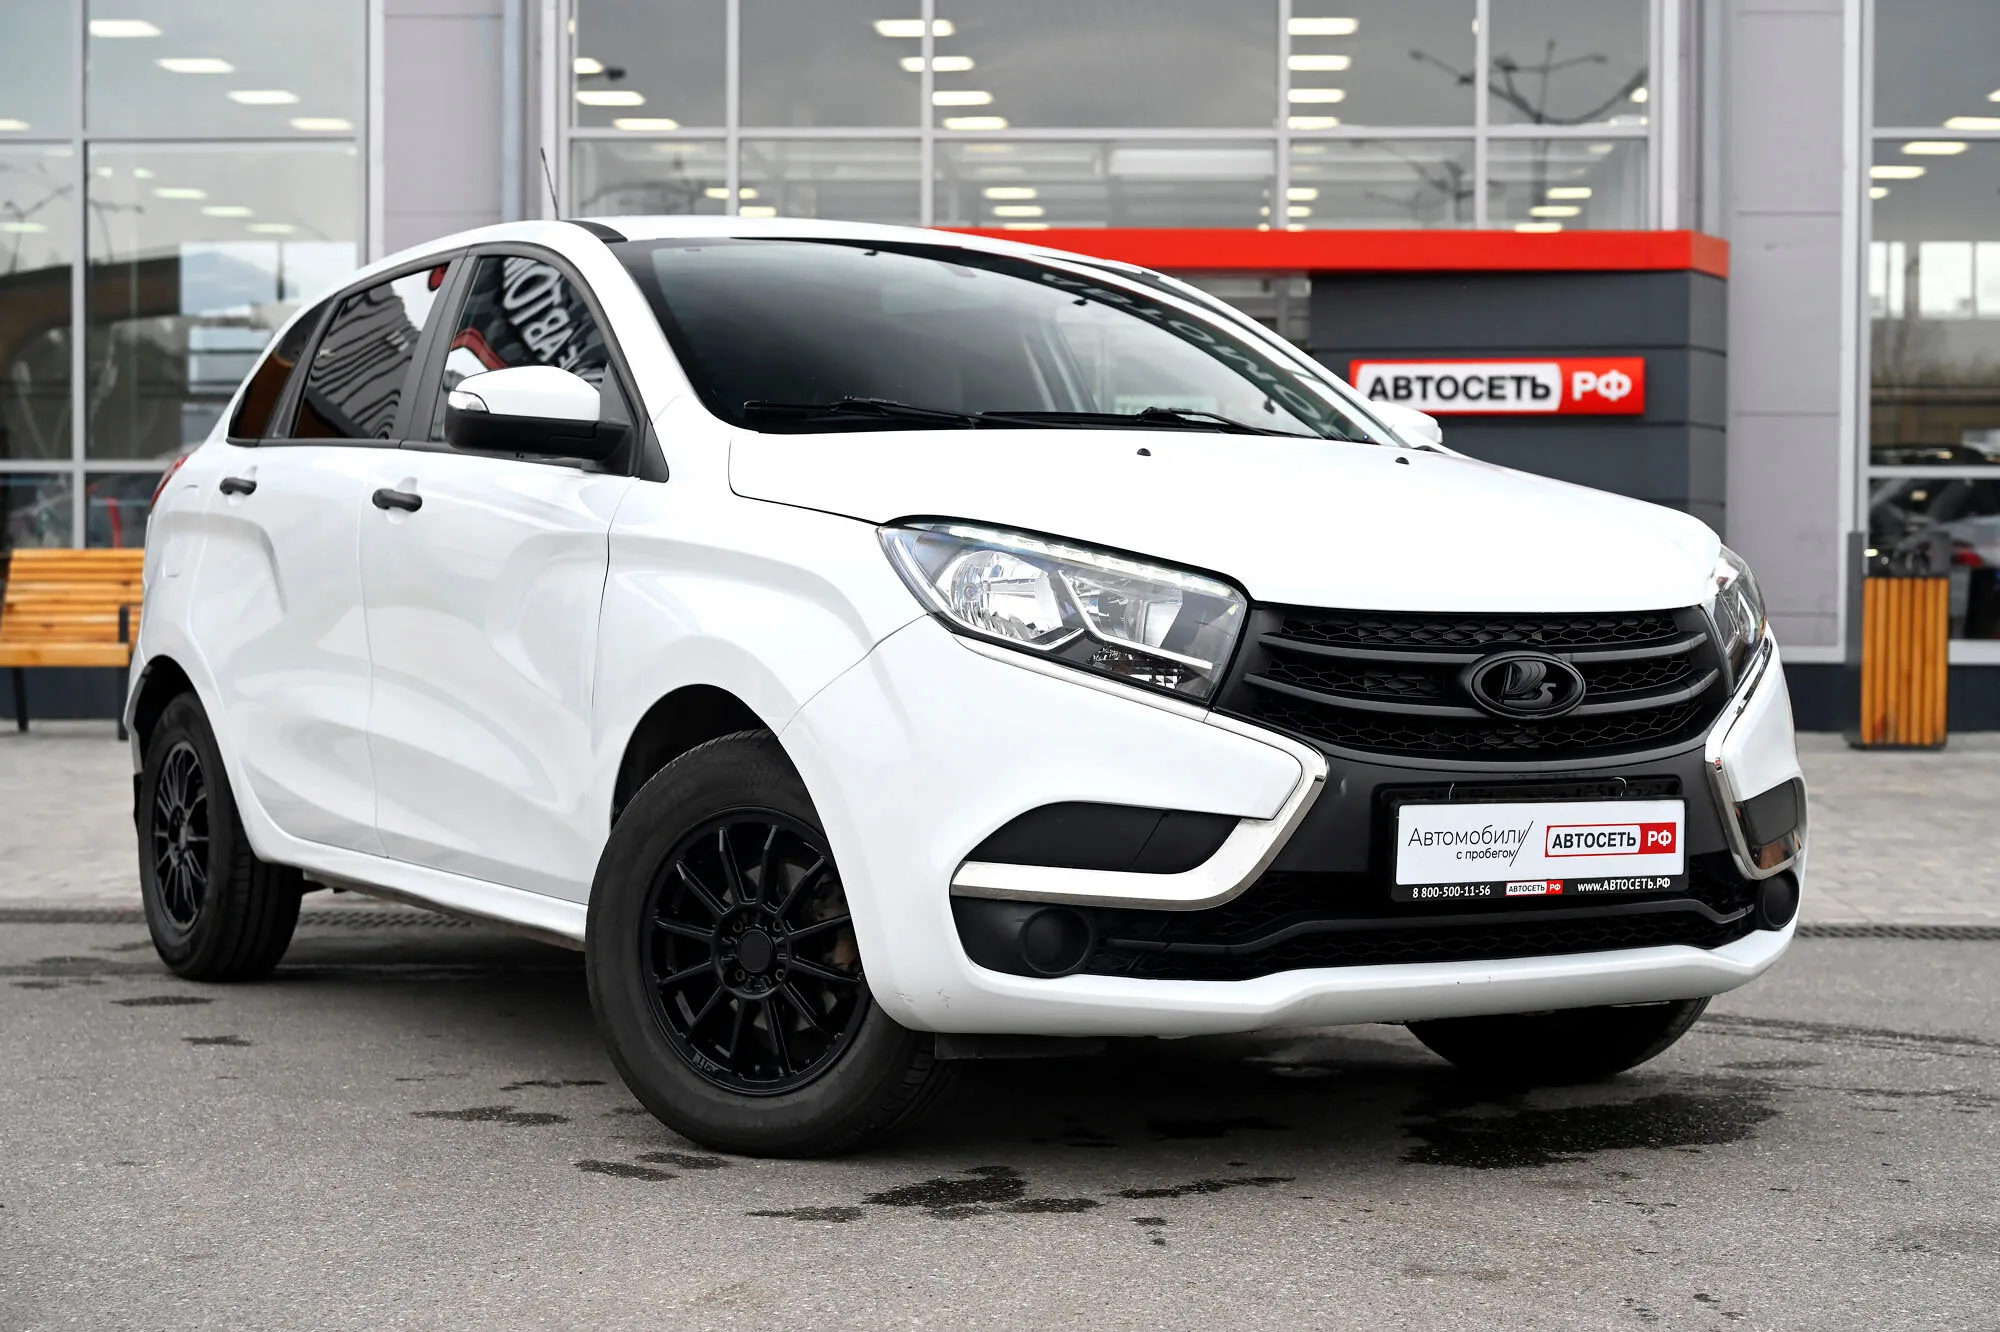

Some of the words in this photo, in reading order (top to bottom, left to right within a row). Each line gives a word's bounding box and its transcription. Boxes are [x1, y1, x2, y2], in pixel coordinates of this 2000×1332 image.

[1368, 376, 1551, 401] АВТОСЕТЬ
[1572, 369, 1632, 401] РФ
[1408, 824, 1526, 846] Автомобили
[1552, 831, 1637, 849] АВТОСЕТЬ
[1647, 829, 1672, 847] РФ
[1456, 850, 1463, 860] с
[1465, 847, 1516, 861] пробегом
[1412, 887, 1419, 898] 8
[1421, 885, 1491, 898] 800-500-11-56
[1508, 884, 1546, 893] АВТОСЕТЬ
[1549, 883, 1562, 891] РФ
[1577, 877, 1671, 893] www.АВТОСЕТЬ.РФ
